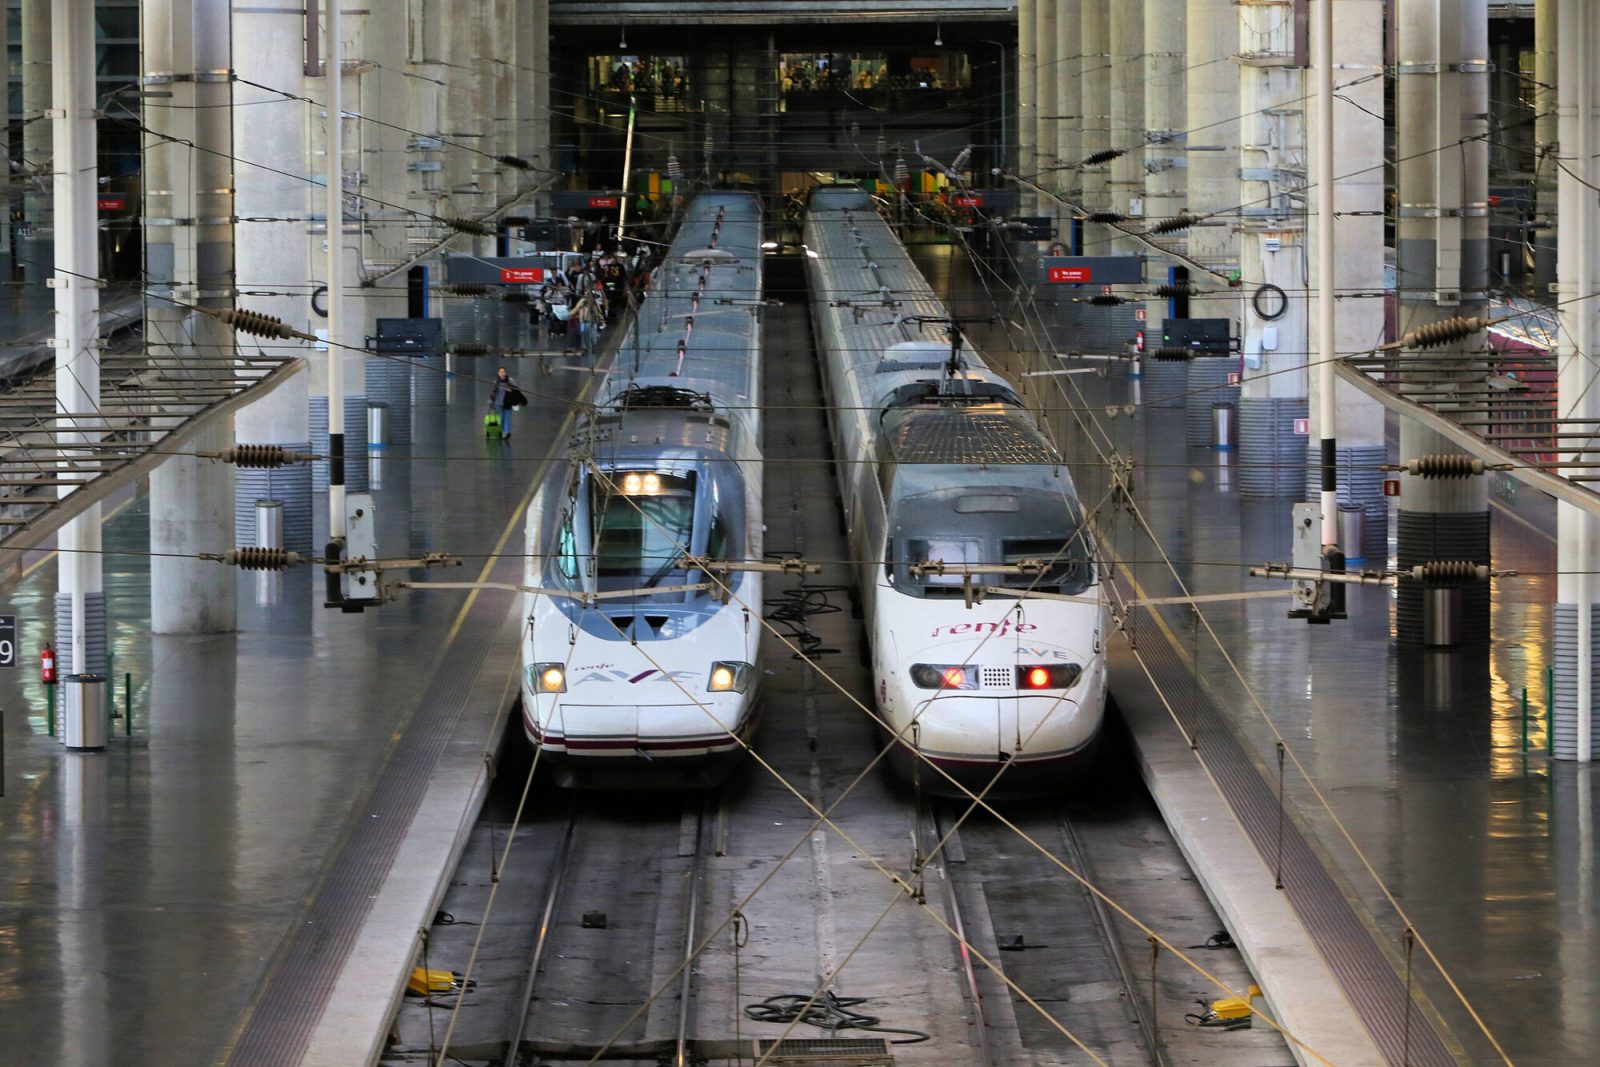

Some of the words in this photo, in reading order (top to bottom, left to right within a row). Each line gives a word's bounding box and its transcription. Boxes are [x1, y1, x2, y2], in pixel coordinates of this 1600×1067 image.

[931, 619, 1037, 637] renfe
[1013, 647, 1068, 660] AVE
[573, 669, 702, 688] AVE
